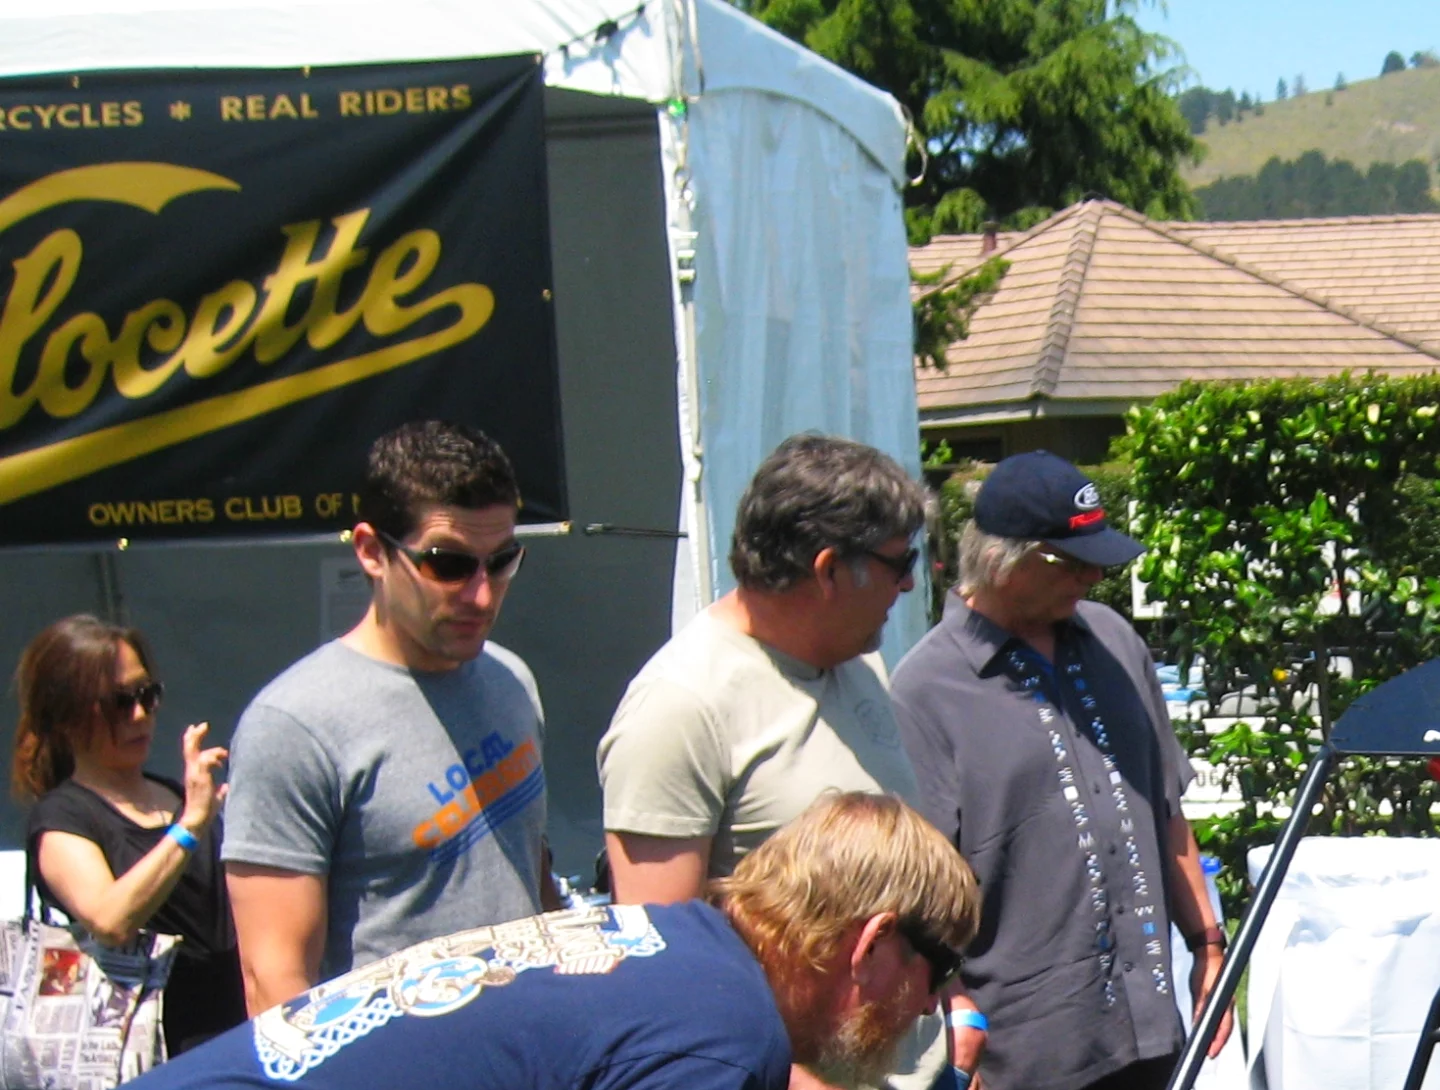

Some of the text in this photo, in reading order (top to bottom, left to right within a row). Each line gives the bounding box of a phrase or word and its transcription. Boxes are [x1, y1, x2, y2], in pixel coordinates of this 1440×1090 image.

[220, 93, 319, 121] REAL
[338, 84, 472, 117] RIDERS
[88, 497, 215, 526] OWNERS
[224, 494, 303, 520] CLUB
[315, 493, 343, 516] OF
[427, 730, 515, 806] LOCAL
